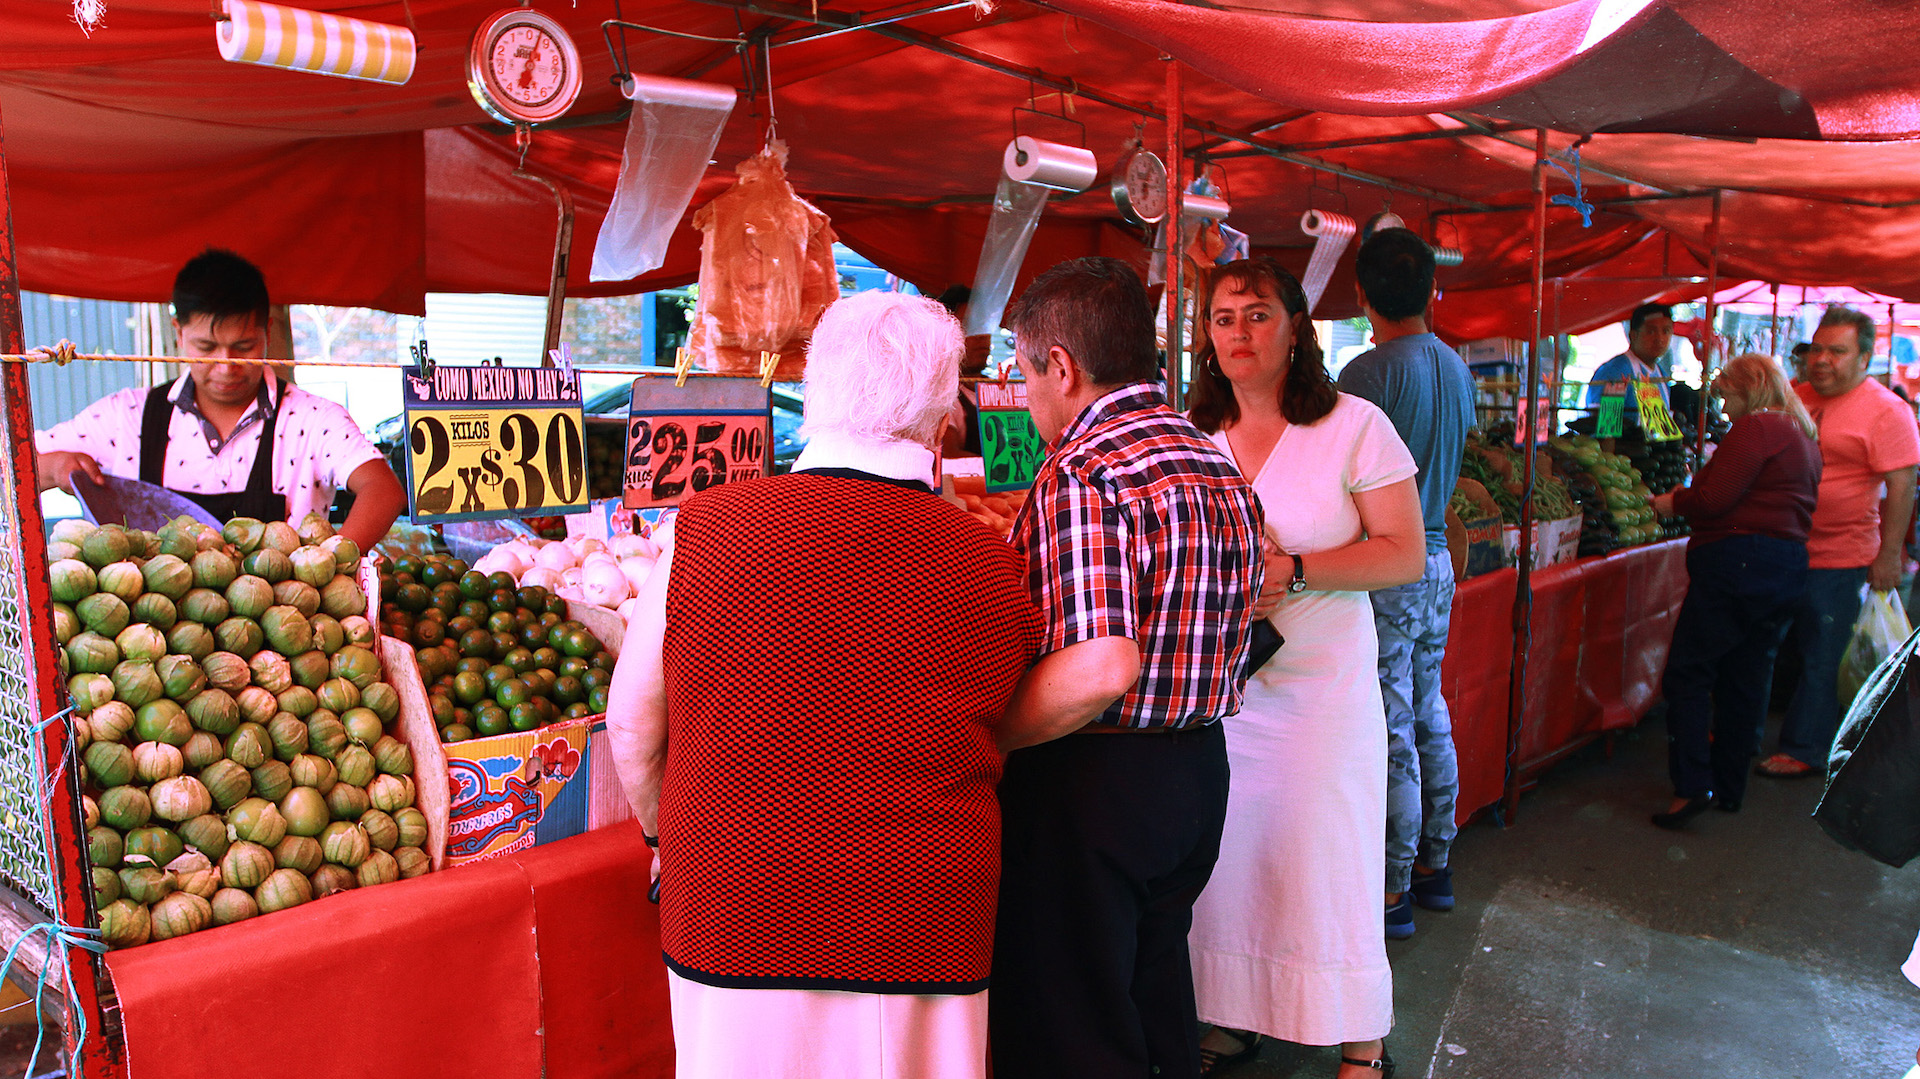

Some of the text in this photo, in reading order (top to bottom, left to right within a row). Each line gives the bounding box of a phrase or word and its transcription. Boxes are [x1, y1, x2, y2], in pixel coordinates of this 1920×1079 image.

[510, 33, 515, 43] 1
[526, 30, 533, 40] 0
[543, 39, 549, 49] 9
[497, 45, 505, 56] 2
[552, 55, 559, 65] 8
[552, 73, 558, 83] 7
[506, 82, 513, 93] 4
[541, 87, 547, 97] 6
[524, 91, 530, 101] 5
[434, 366, 469, 401] COMO
[471, 367, 515, 401] MEXICO
[517, 368, 534, 401] NO
[536, 369, 559, 401] HAY
[1006, 415, 1026, 431] KILOS
[451, 420, 490, 440] KILOS
[984, 414, 1011, 484] 2
[411, 416, 454, 516] 2
[629, 420, 763, 501] 2 25 00
[624, 469, 653, 485] KILOS
